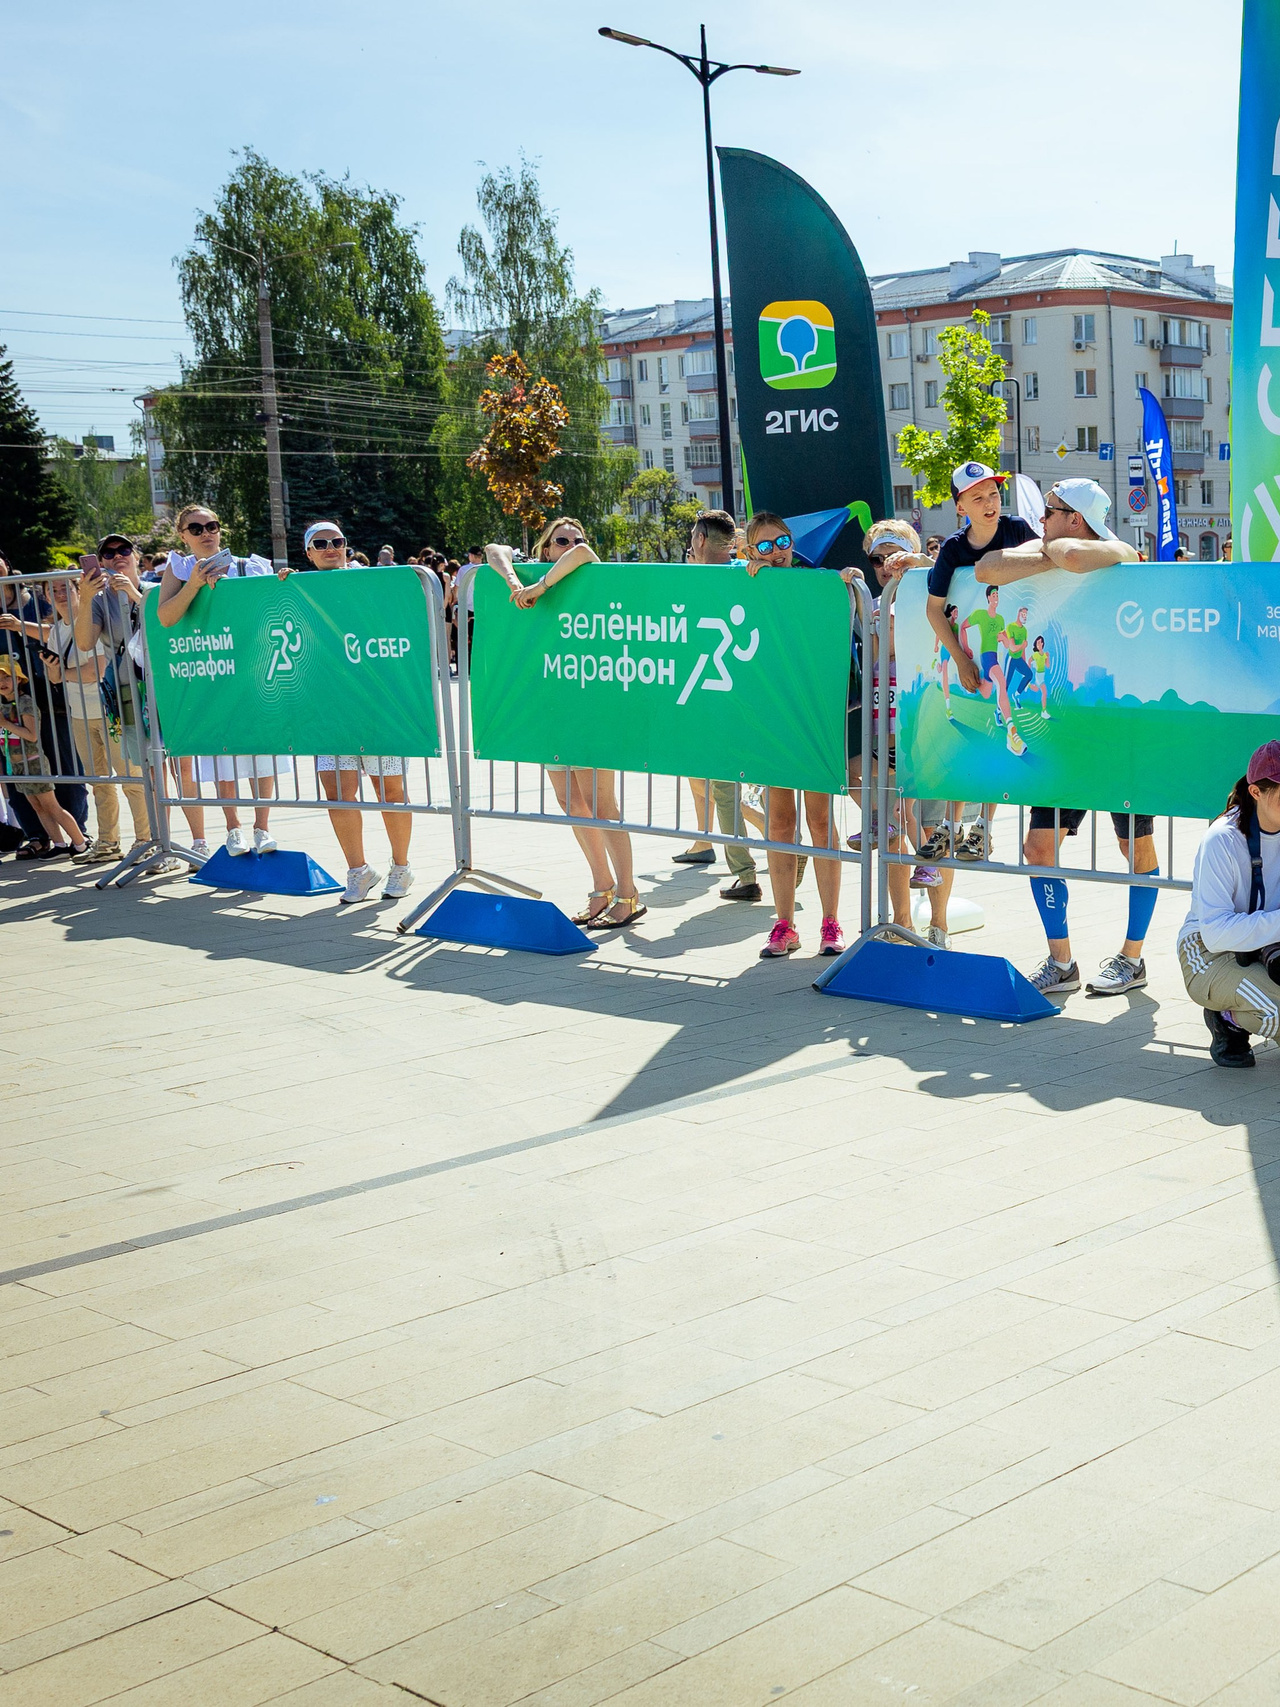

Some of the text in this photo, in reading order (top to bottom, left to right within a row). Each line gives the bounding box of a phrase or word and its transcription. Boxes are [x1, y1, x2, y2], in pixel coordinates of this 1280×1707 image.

[765, 408, 839, 434] 2ГИС
[1178, 518, 1208, 528] РЕЖНАЯ
[557, 602, 688, 643] зелёный
[1151, 608, 1221, 633] СБЕР
[169, 626, 234, 654] зелёный
[366, 637, 411, 659] СБЕР
[169, 653, 236, 682] марафон
[543, 645, 675, 692] марафон
[1043, 883, 1056, 909] 2XU
